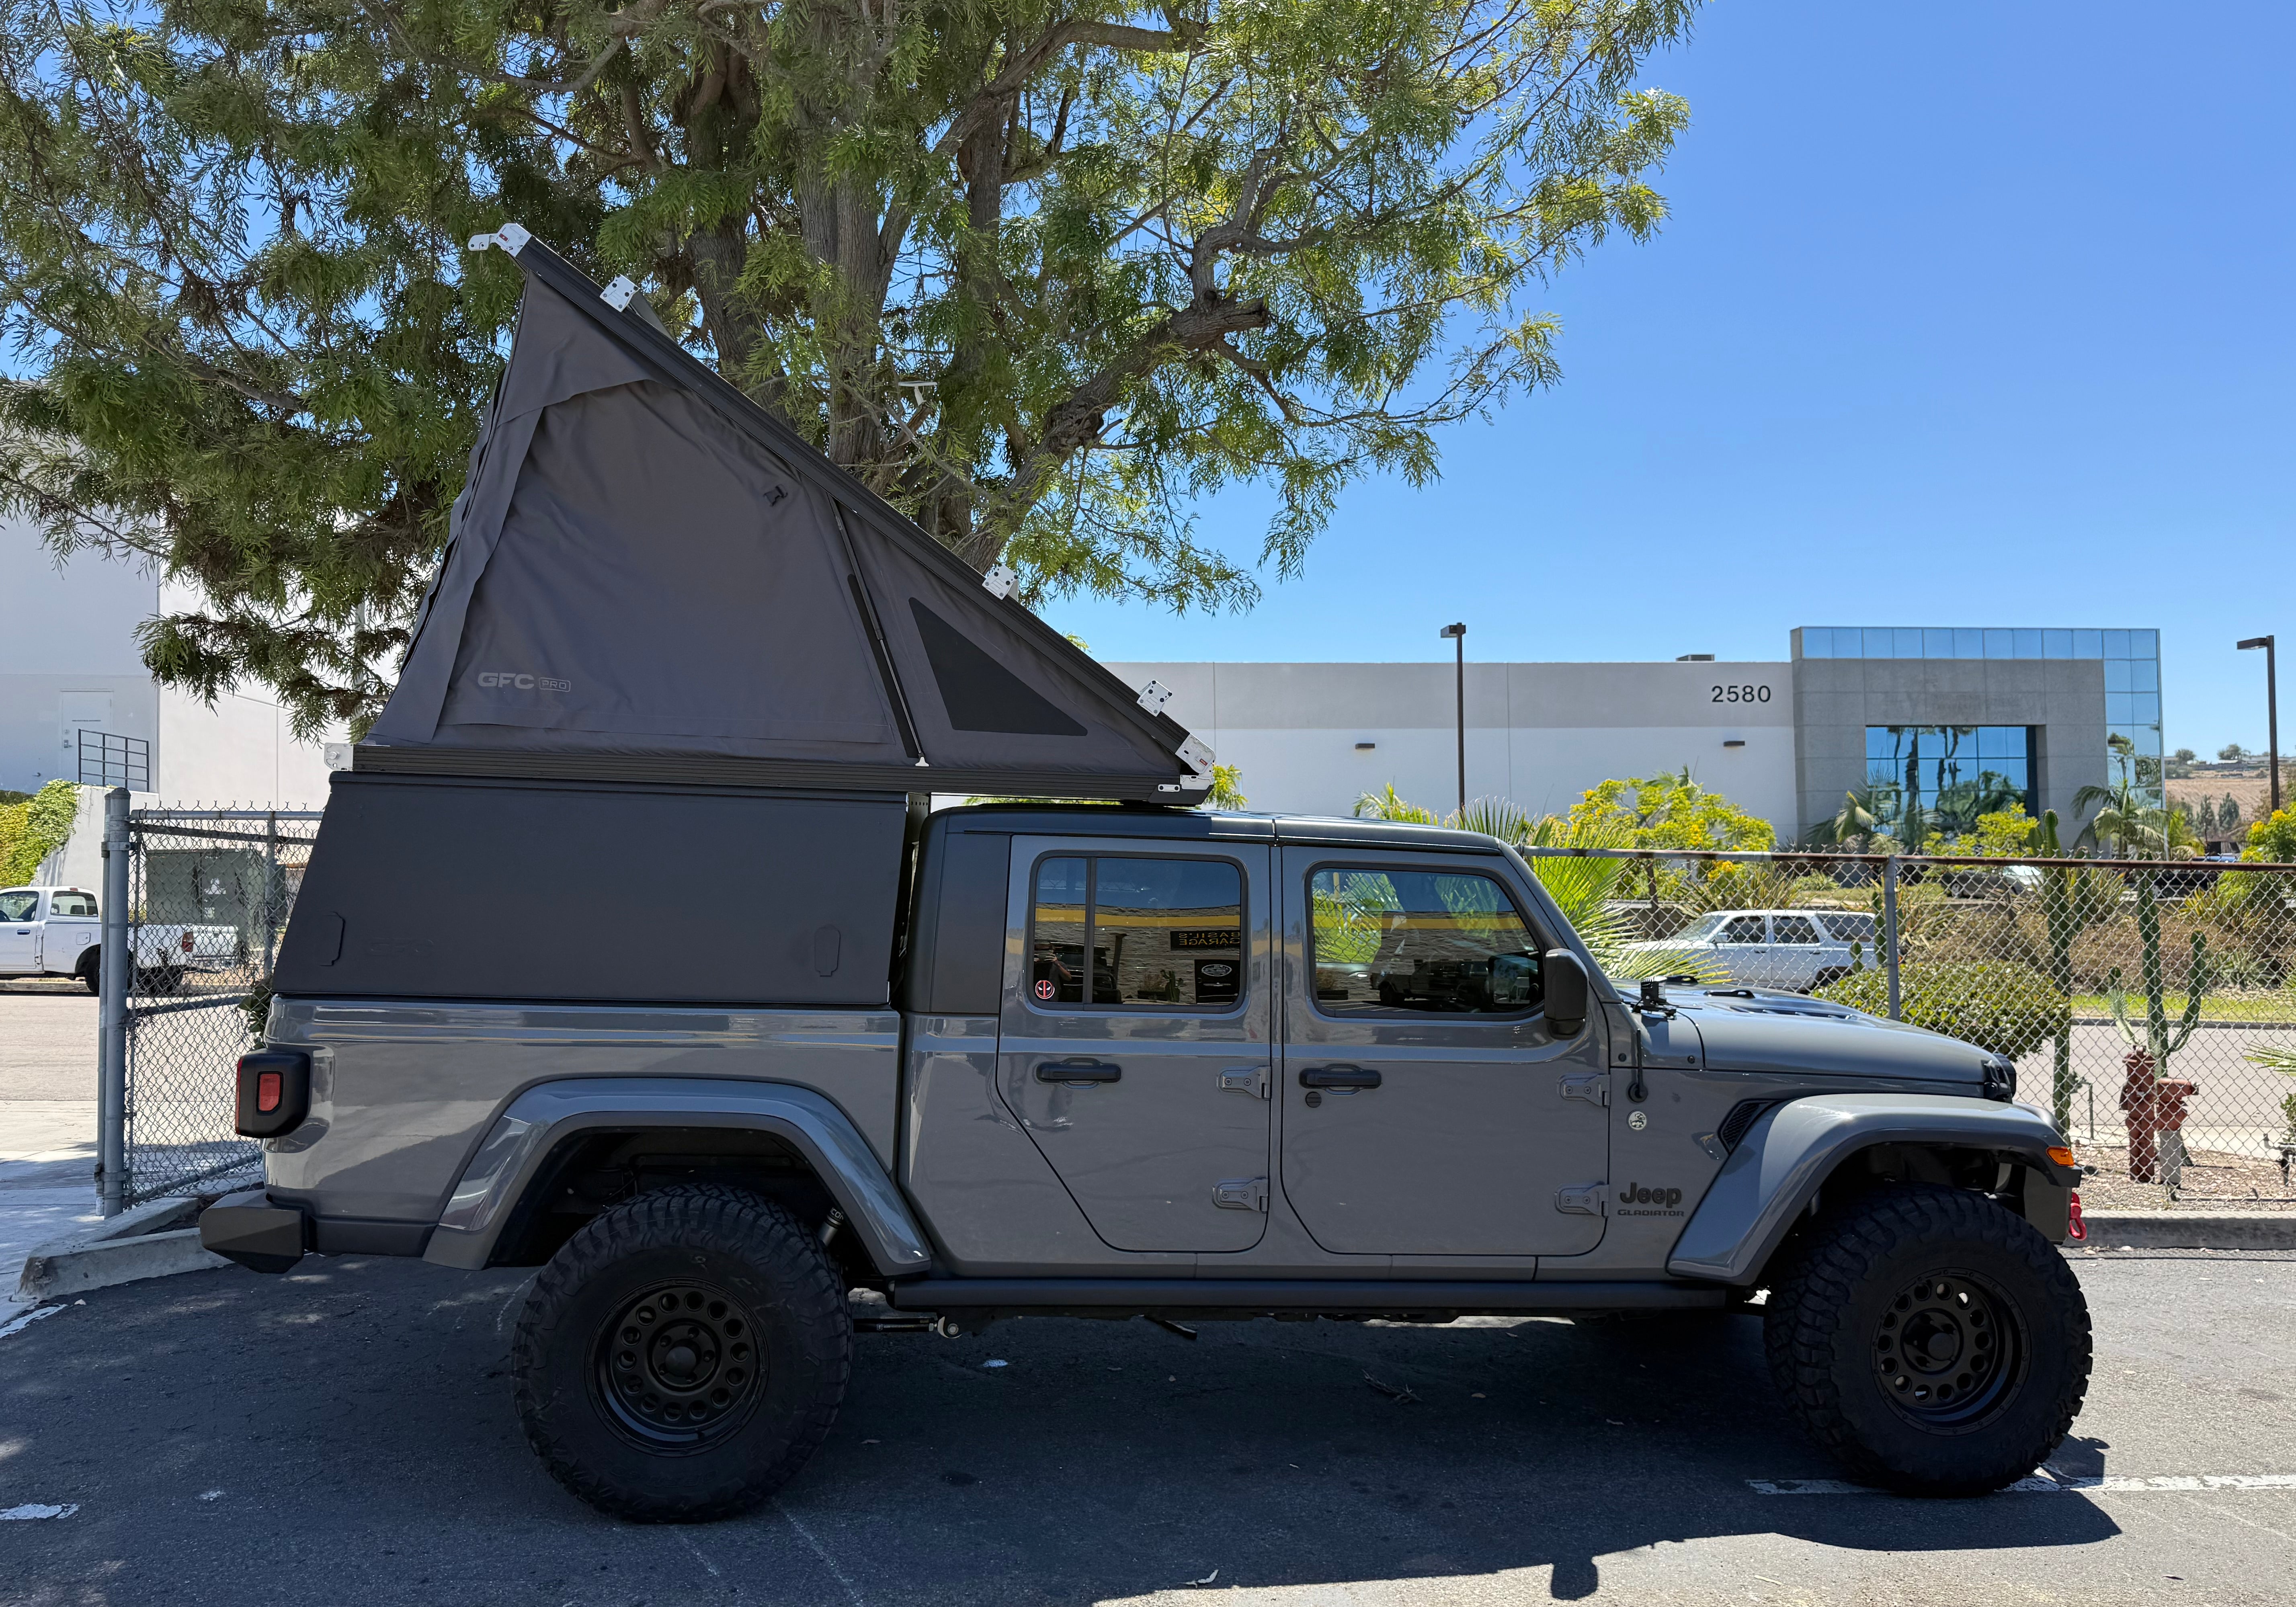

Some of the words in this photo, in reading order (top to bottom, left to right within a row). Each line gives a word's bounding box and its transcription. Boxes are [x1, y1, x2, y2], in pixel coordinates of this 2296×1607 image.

[478, 672, 534, 689] GFC
[541, 680, 567, 689] PRO
[1711, 685, 1771, 703] 2580
[1620, 1182, 1682, 1208] Jeep
